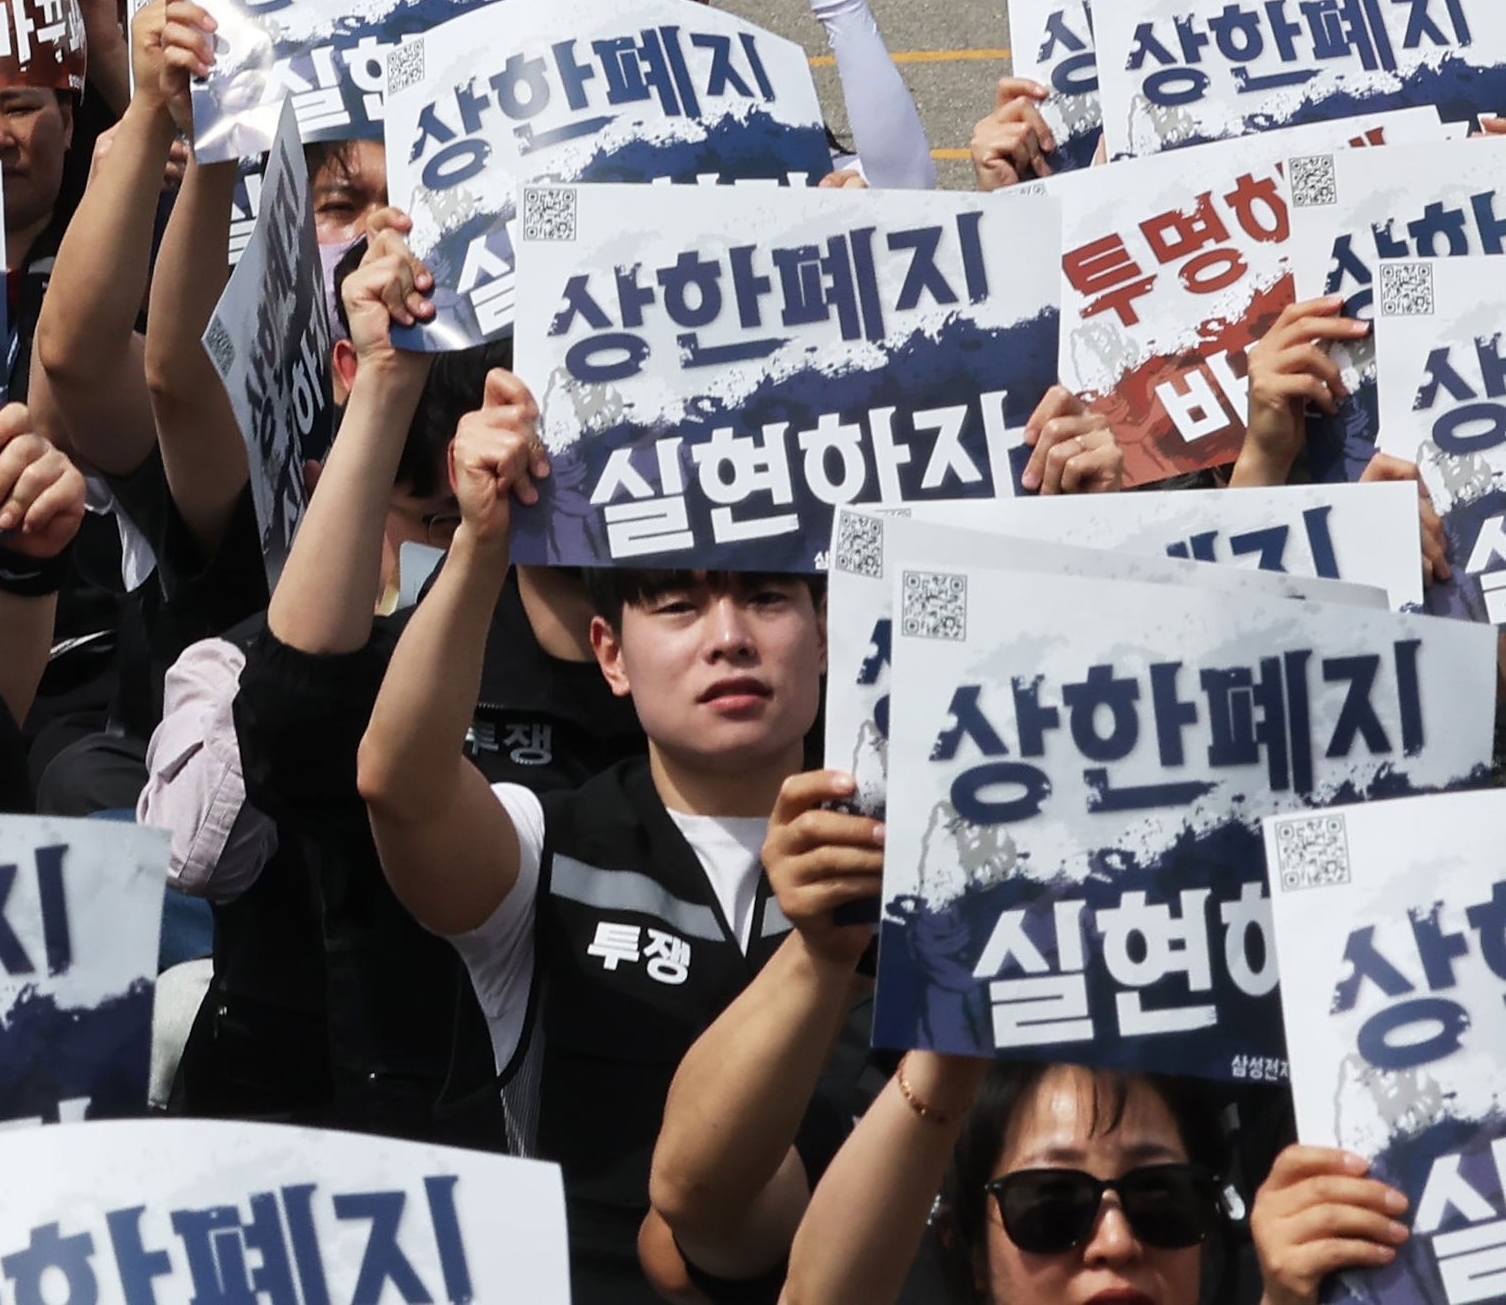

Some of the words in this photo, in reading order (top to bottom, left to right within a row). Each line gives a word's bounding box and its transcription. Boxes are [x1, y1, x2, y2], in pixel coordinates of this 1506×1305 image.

[410, 26, 776, 190] 상한폐지
[548, 211, 991, 383] 상한폐지
[589, 392, 1033, 559] 실현하자
[463, 722, 553, 767] 투쟁
[930, 639, 1424, 824] 상한폐지
[587, 920, 690, 983] 투쟁
[972, 891, 1281, 1050] 실현
